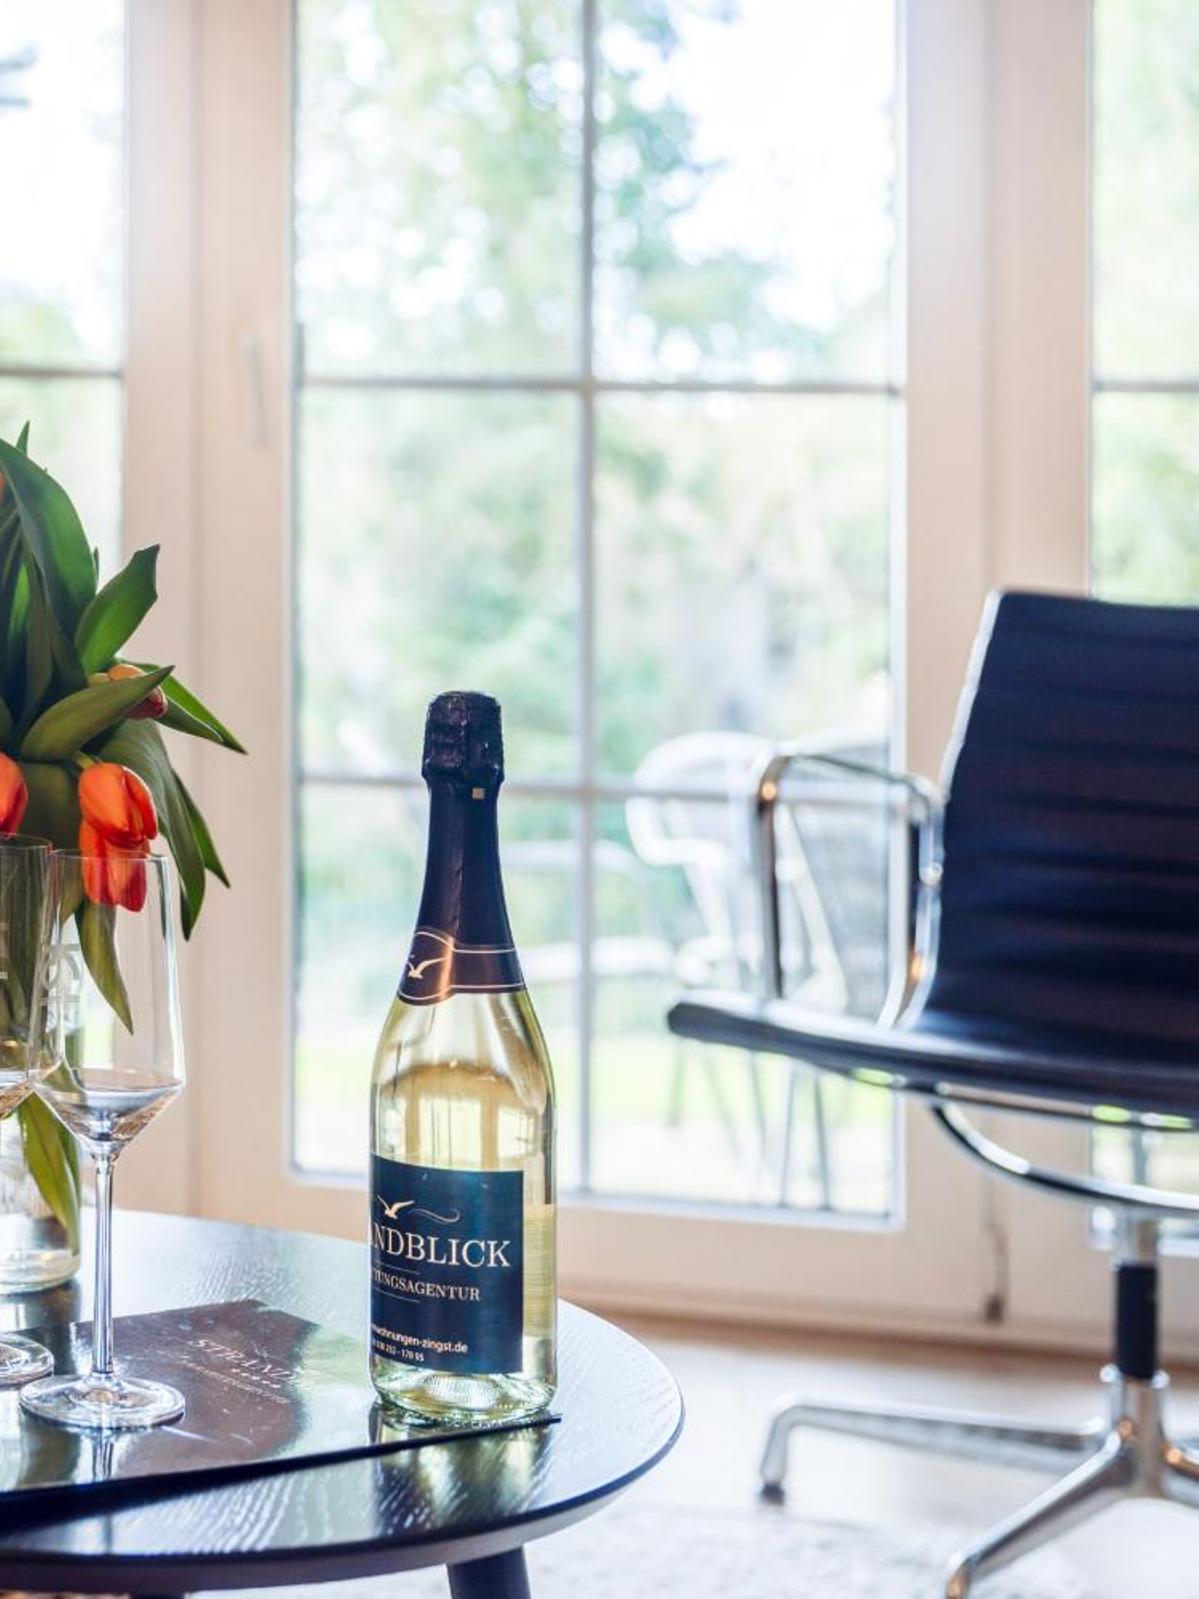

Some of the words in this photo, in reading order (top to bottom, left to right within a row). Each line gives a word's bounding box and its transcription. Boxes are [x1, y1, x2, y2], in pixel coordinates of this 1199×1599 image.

[372, 1222, 511, 1267] NDBLICK
[372, 1267, 480, 1301] TUNGSAGENTUR
[371, 1323, 468, 1353] ohnungen-zingst.de
